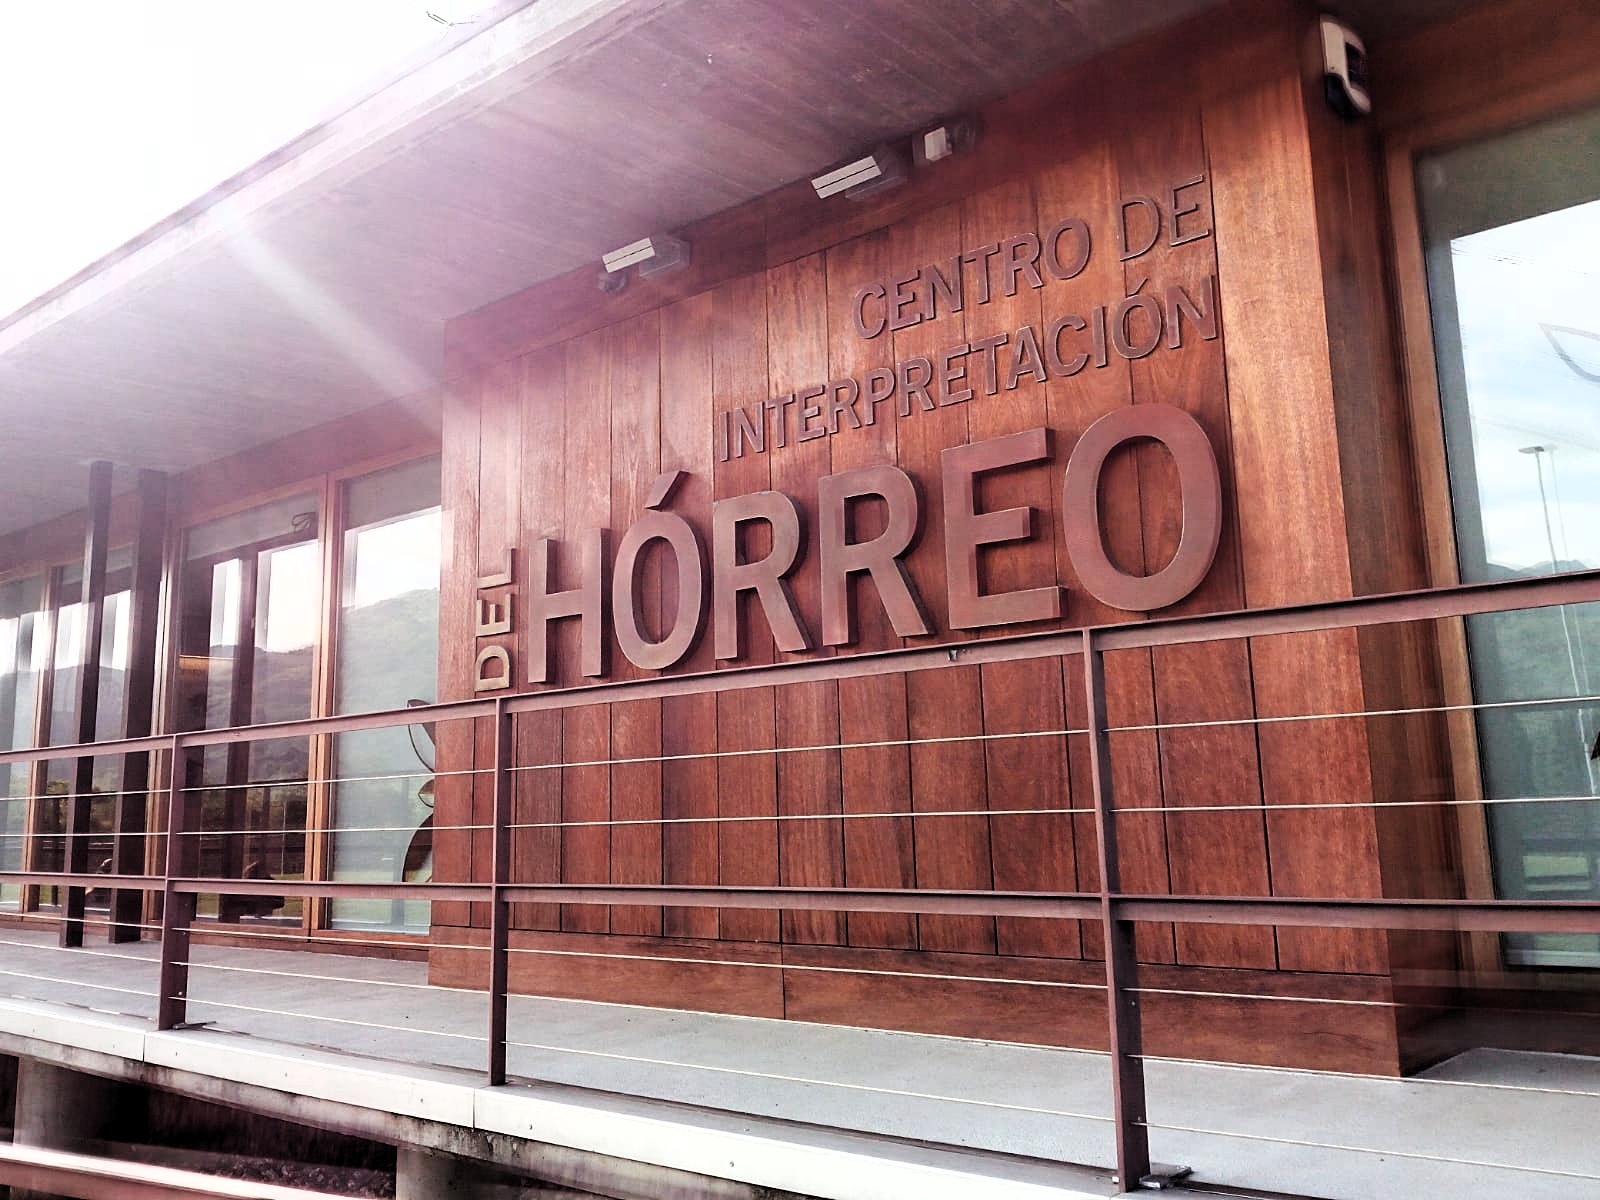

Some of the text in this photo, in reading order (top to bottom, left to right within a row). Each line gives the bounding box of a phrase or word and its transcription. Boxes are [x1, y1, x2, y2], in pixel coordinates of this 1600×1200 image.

[853, 174, 1210, 339] CENTRO DE
[718, 275, 1218, 462] INTERPRETACIÓN
[475, 547, 515, 692] DEL
[527, 402, 1223, 684] HÓRREO
